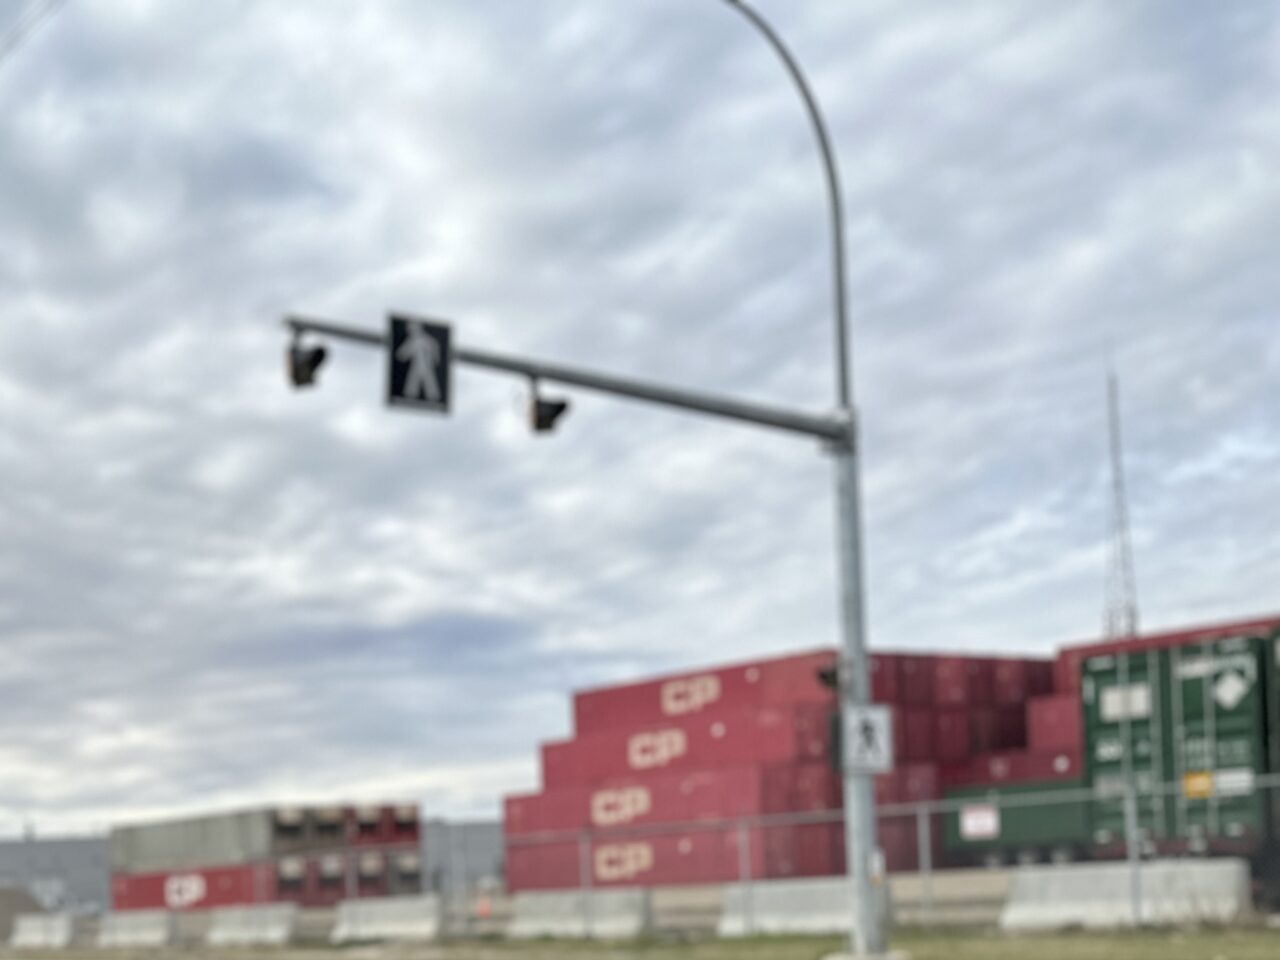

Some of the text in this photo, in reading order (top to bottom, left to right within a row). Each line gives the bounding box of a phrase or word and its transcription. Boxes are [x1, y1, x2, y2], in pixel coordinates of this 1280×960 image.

[661, 673, 720, 716] CP
[628, 728, 686, 769] CP
[591, 786, 651, 826] CP
[594, 843, 653, 881] CP
